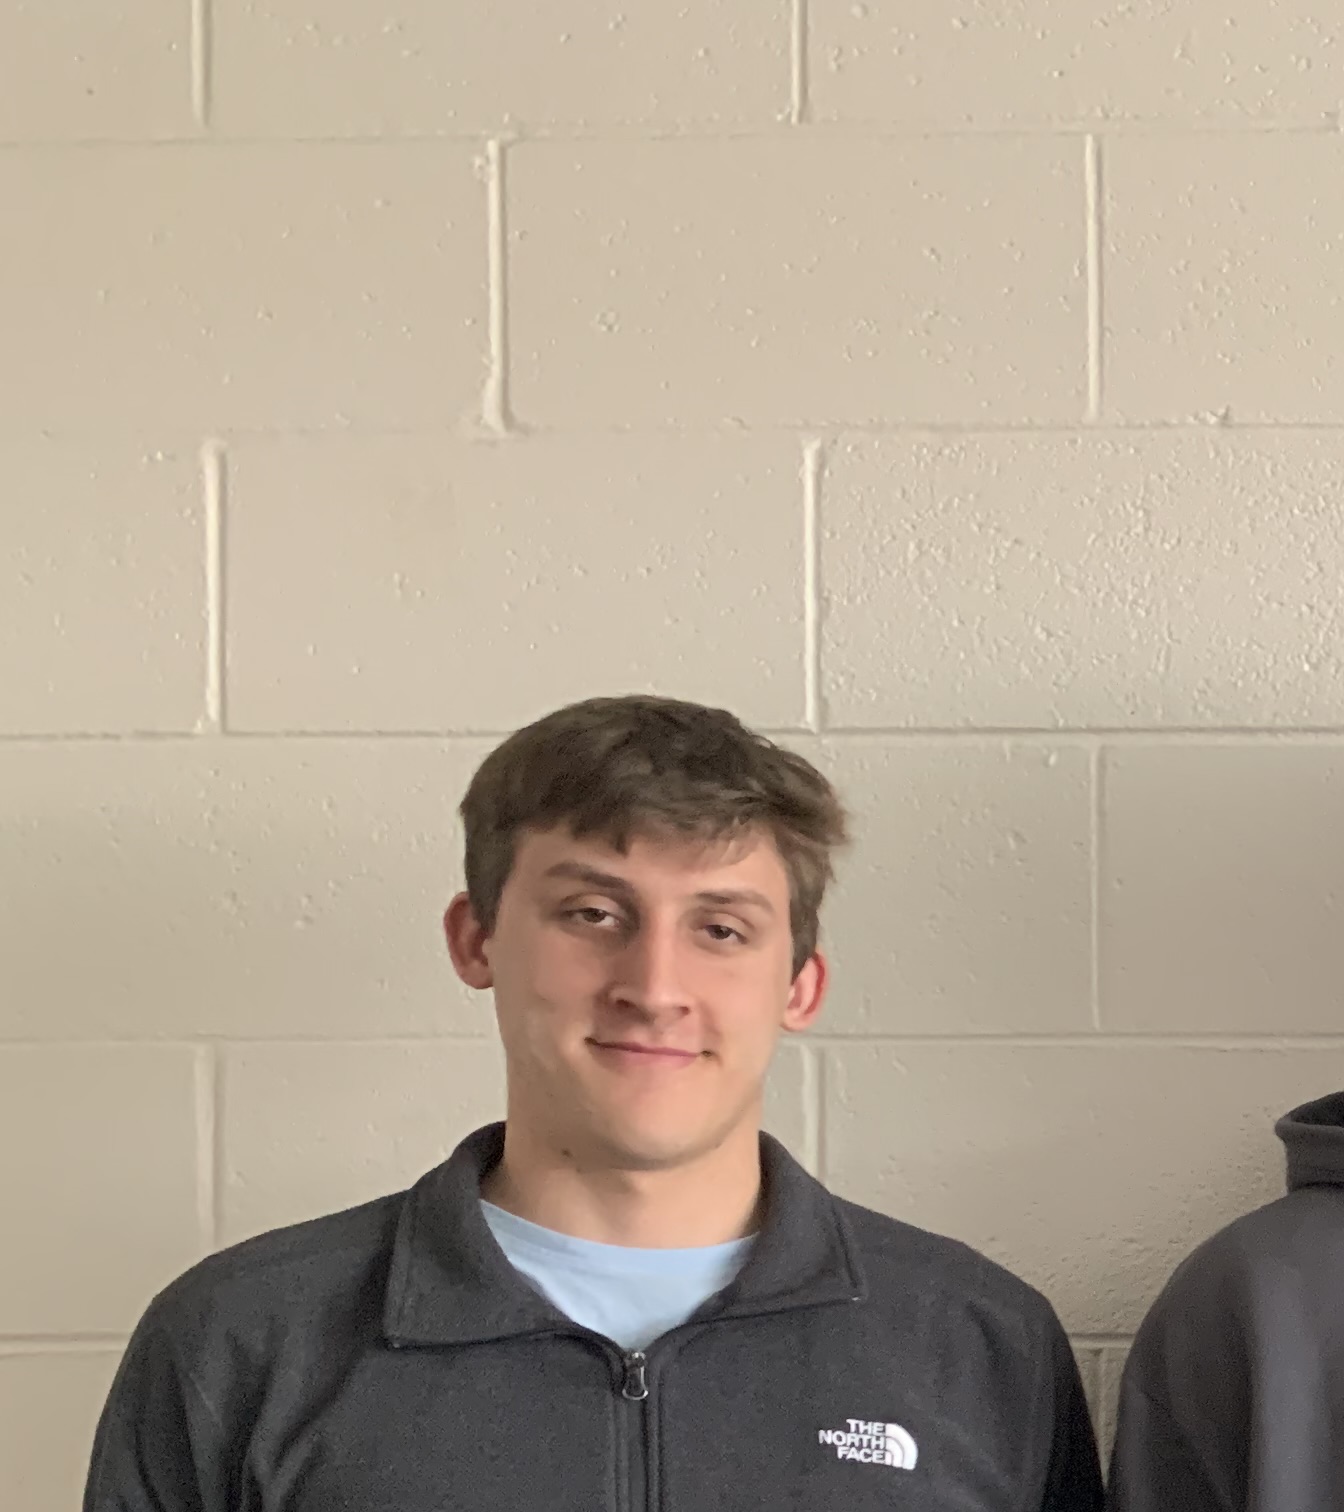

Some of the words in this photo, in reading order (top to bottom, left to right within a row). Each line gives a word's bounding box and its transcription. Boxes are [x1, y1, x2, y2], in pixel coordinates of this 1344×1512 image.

[846, 1419, 885, 1435] THE
[818, 1430, 885, 1449] NORTH
[837, 1446, 885, 1464] FACE
